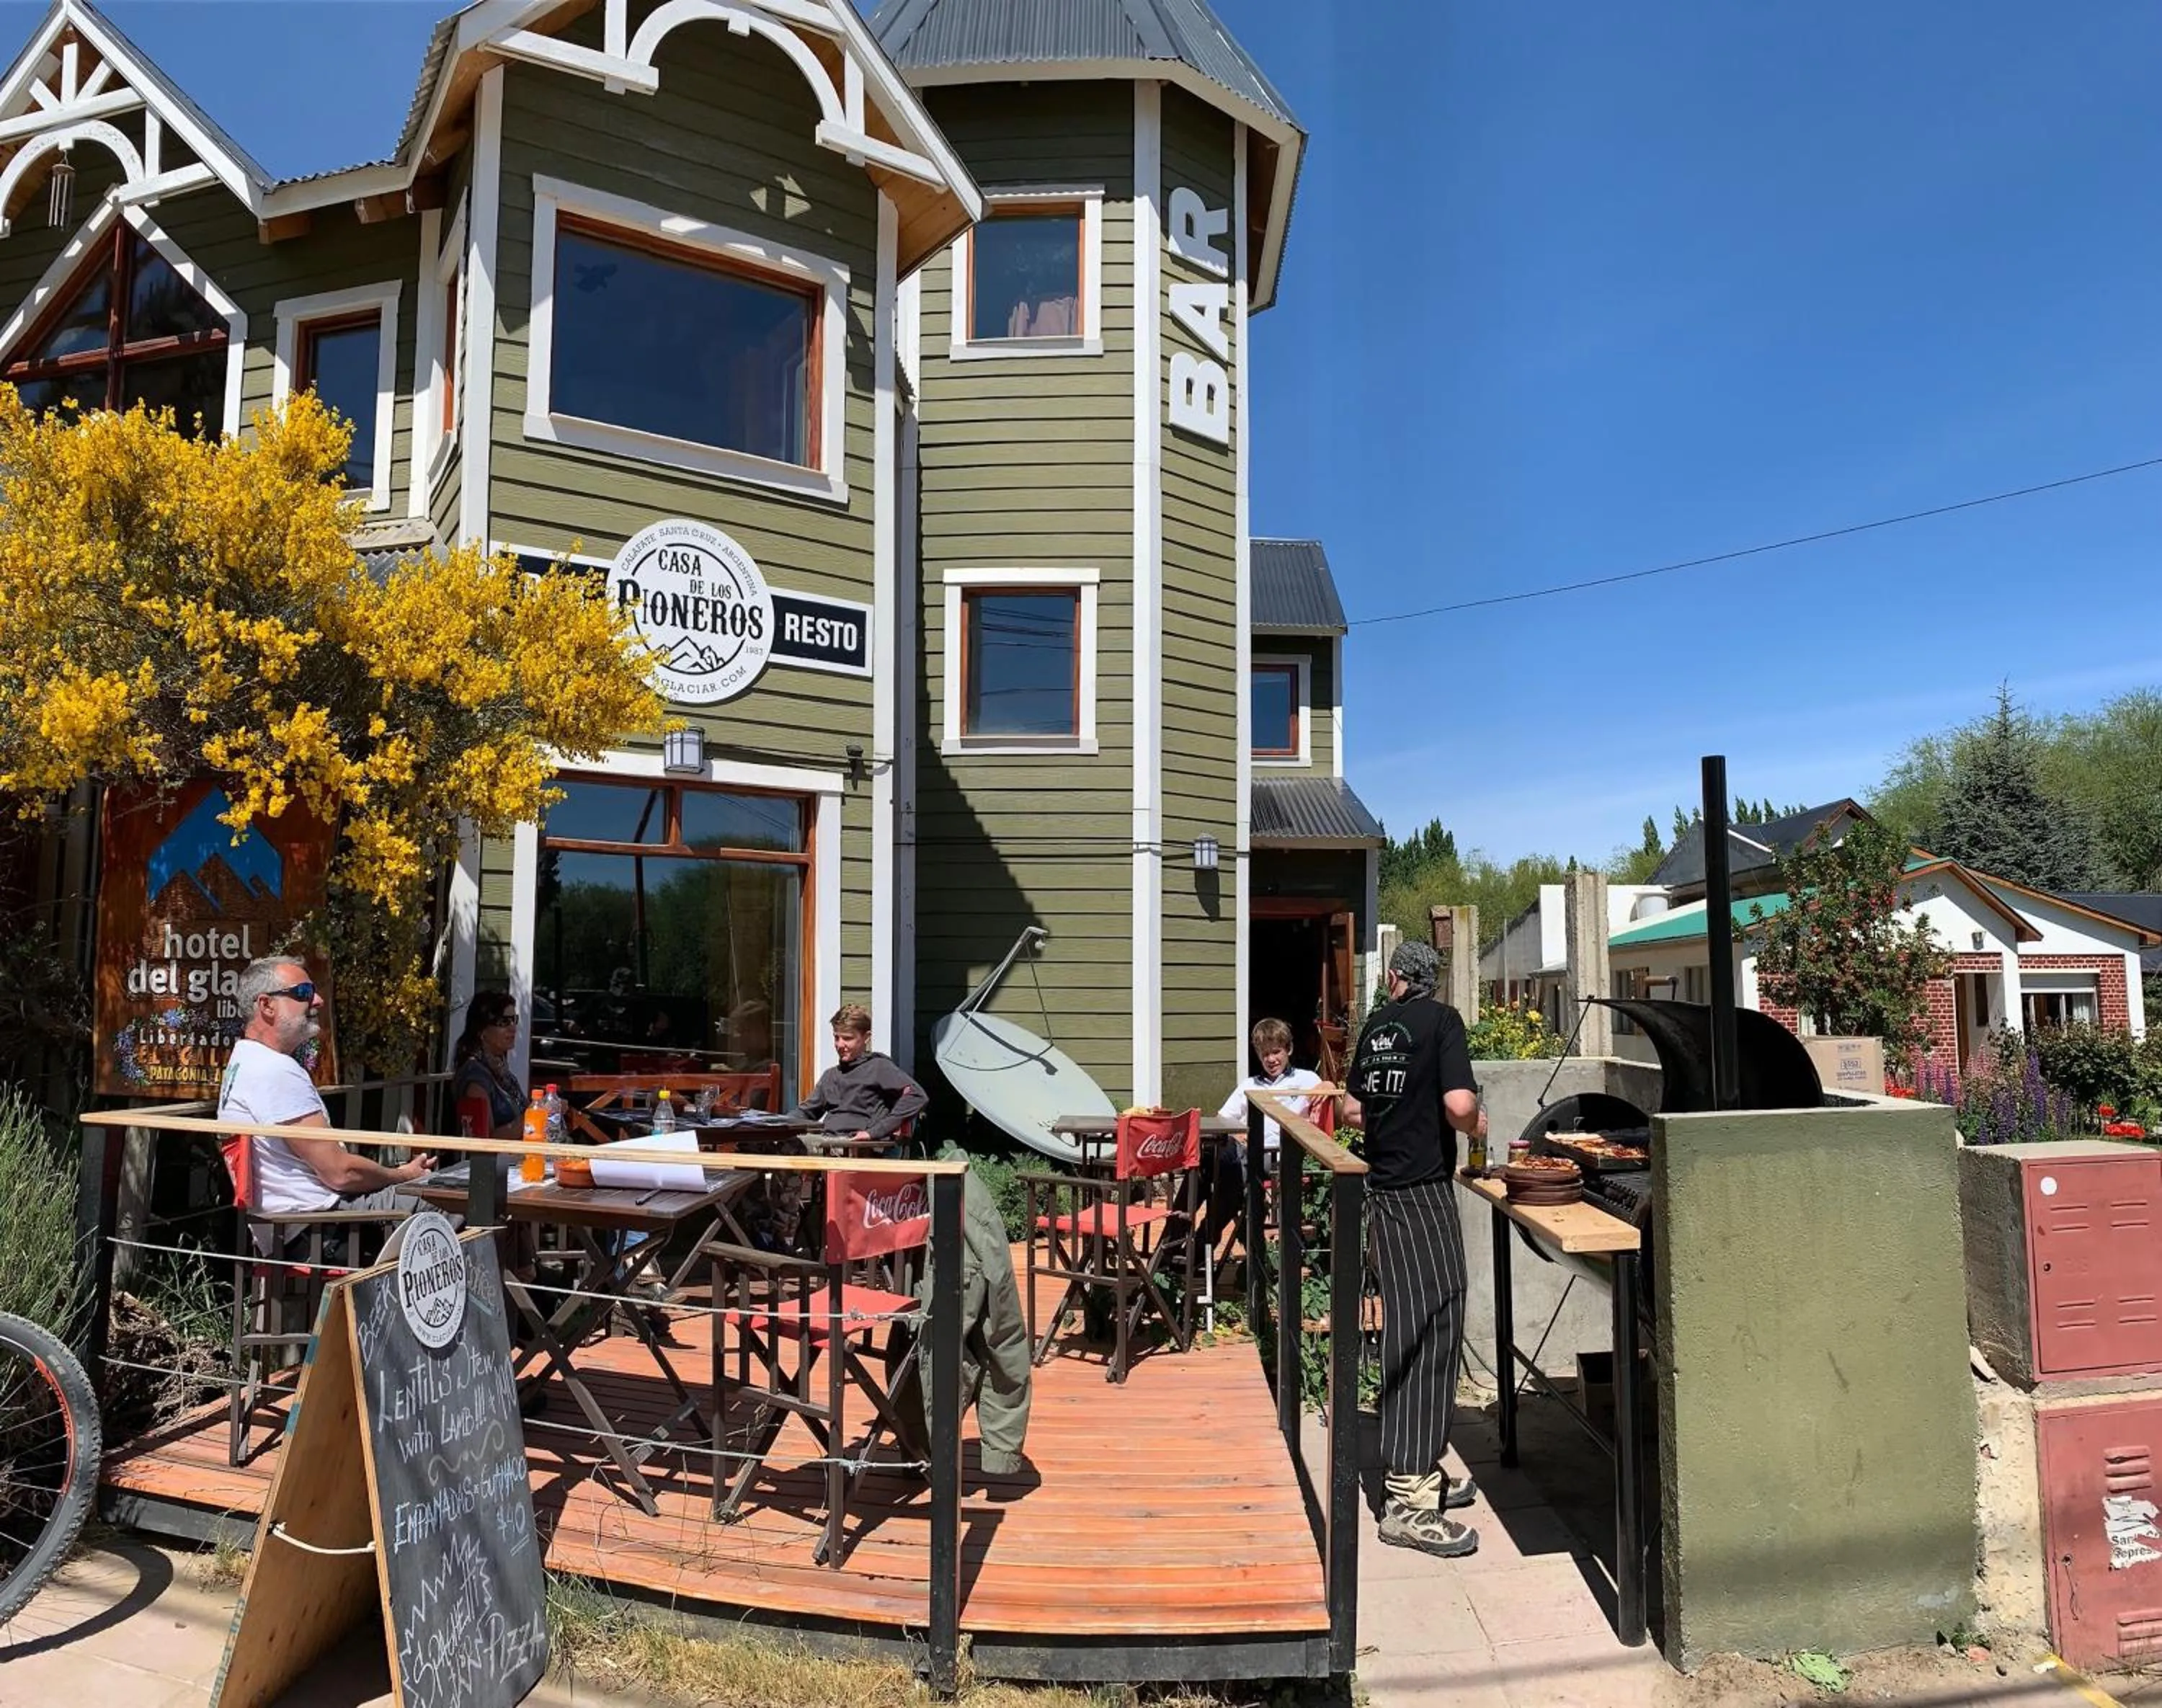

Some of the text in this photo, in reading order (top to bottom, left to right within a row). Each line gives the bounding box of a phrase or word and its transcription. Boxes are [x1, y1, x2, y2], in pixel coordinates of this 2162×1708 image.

[1168, 187, 1229, 445] BAR
[659, 526, 690, 538] SANTA
[657, 548, 703, 577] CASA
[689, 579, 732, 600] DE LOS
[617, 579, 764, 640] PIONEROS
[784, 613, 858, 651] RESTO
[163, 923, 252, 959] hotel
[128, 958, 179, 995] del
[402, 1255, 464, 1309] PIONEROS
